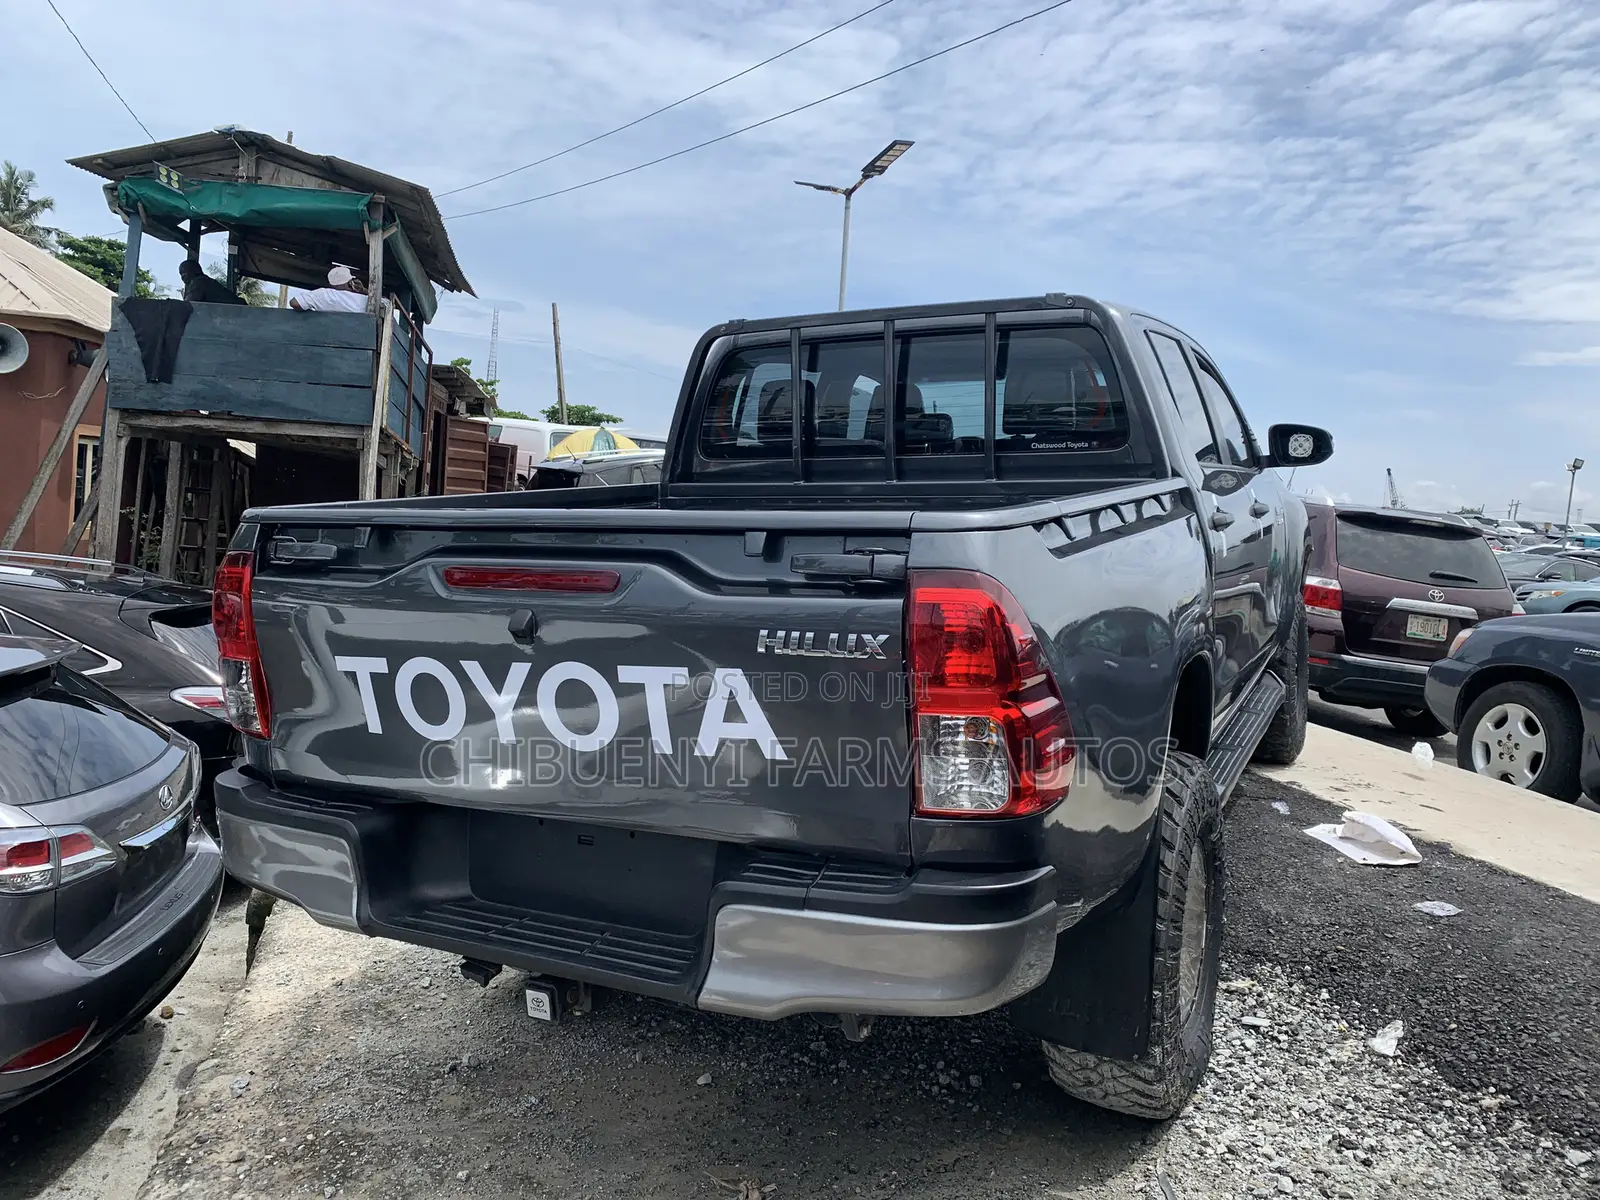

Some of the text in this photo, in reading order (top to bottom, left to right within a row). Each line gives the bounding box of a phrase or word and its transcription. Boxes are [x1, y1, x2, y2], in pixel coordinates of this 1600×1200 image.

[1067, 441, 1088, 449] Toyota
[757, 629, 890, 660] HILUX
[334, 655, 789, 761] TOYOTA
